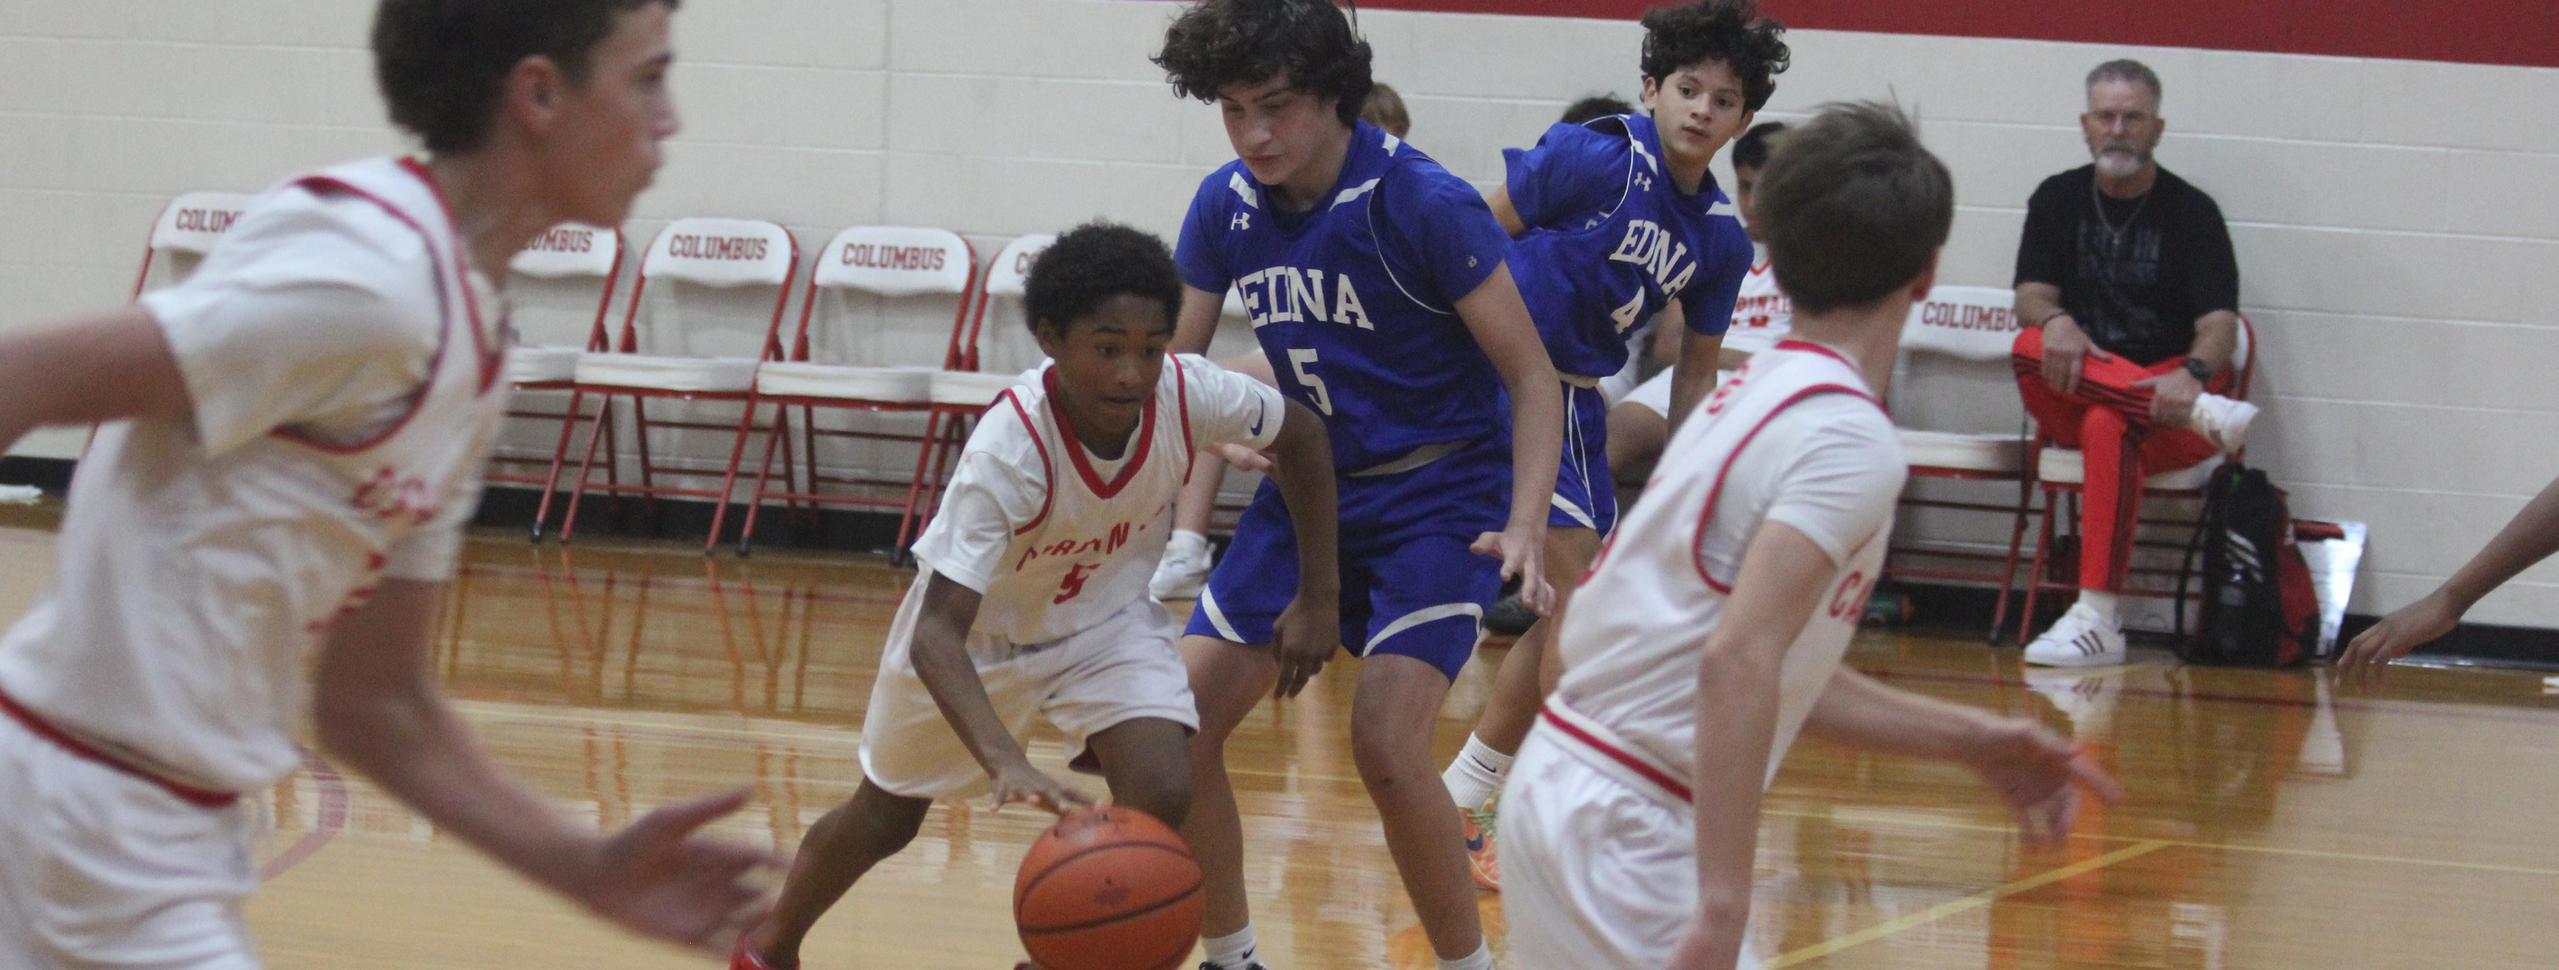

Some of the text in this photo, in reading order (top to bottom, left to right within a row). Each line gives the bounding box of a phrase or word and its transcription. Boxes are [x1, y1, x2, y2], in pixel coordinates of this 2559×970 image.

[669, 235, 768, 260] COLUMBUS
[842, 244, 946, 270] COLUMBUS
[1608, 219, 1697, 302] EDNA
[1239, 266, 1375, 331] EDNA
[1611, 285, 1646, 335] 4
[1922, 302, 2019, 332] COLUMBU
[1287, 349, 1332, 416] 5
[1053, 563, 1101, 605] 5
